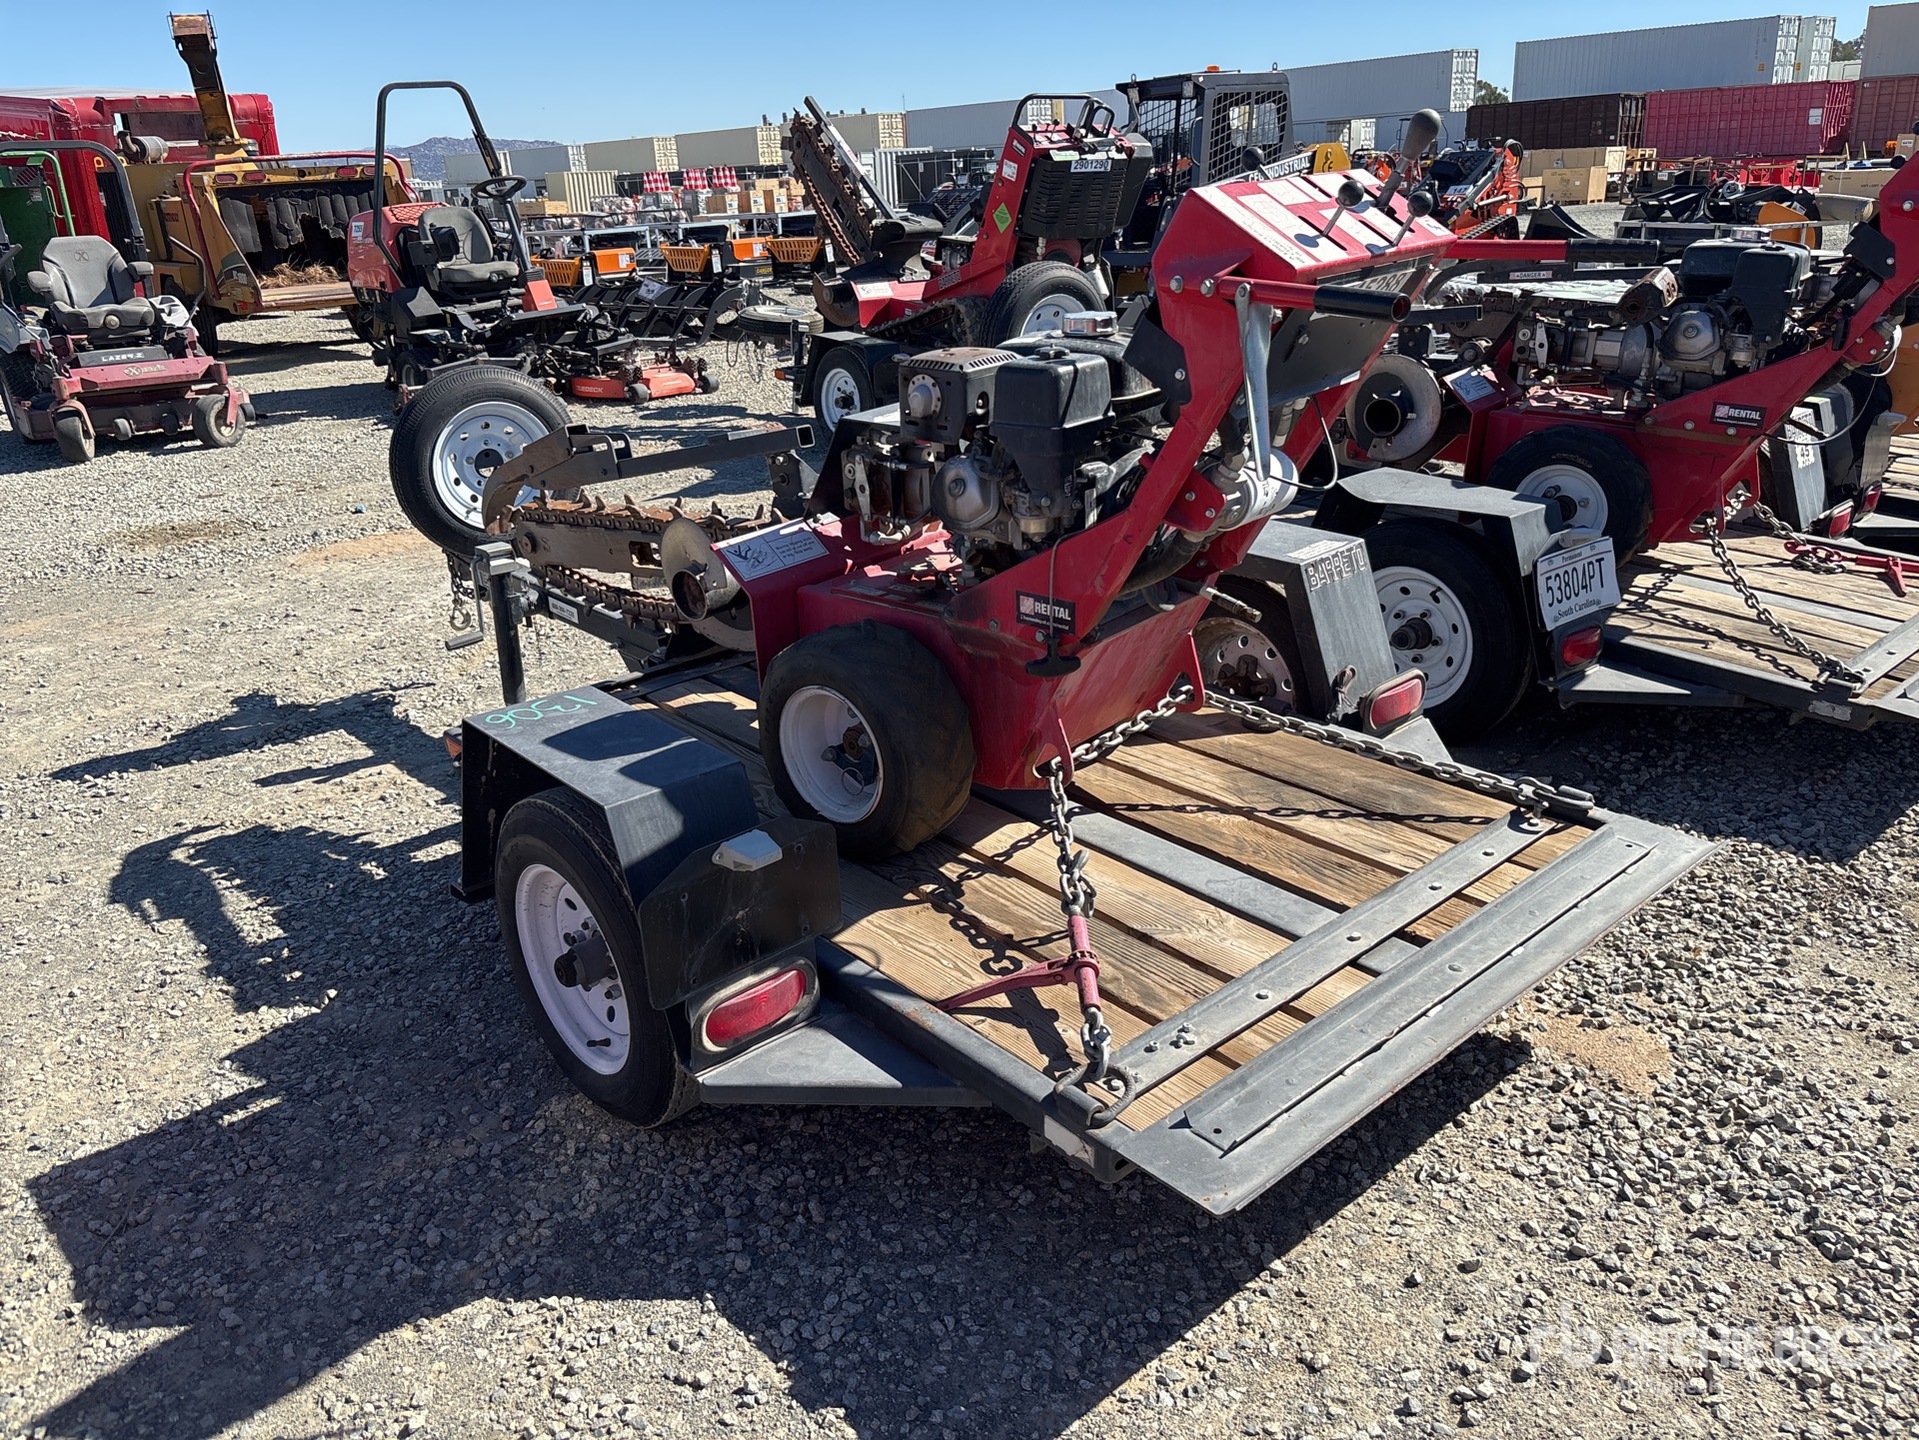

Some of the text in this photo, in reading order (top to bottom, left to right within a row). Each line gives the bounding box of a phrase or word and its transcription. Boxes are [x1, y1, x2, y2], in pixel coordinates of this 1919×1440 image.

[1073, 160, 1109, 171] 2901290
[1519, 271, 1542, 279] DANGER
[1728, 408, 1762, 420] RENTAL
[1561, 551, 1583, 563] Permanent
[1545, 557, 1604, 608] 53804PT
[1034, 601, 1071, 621] RENTAL
[1557, 598, 1596, 618] South Carolina
